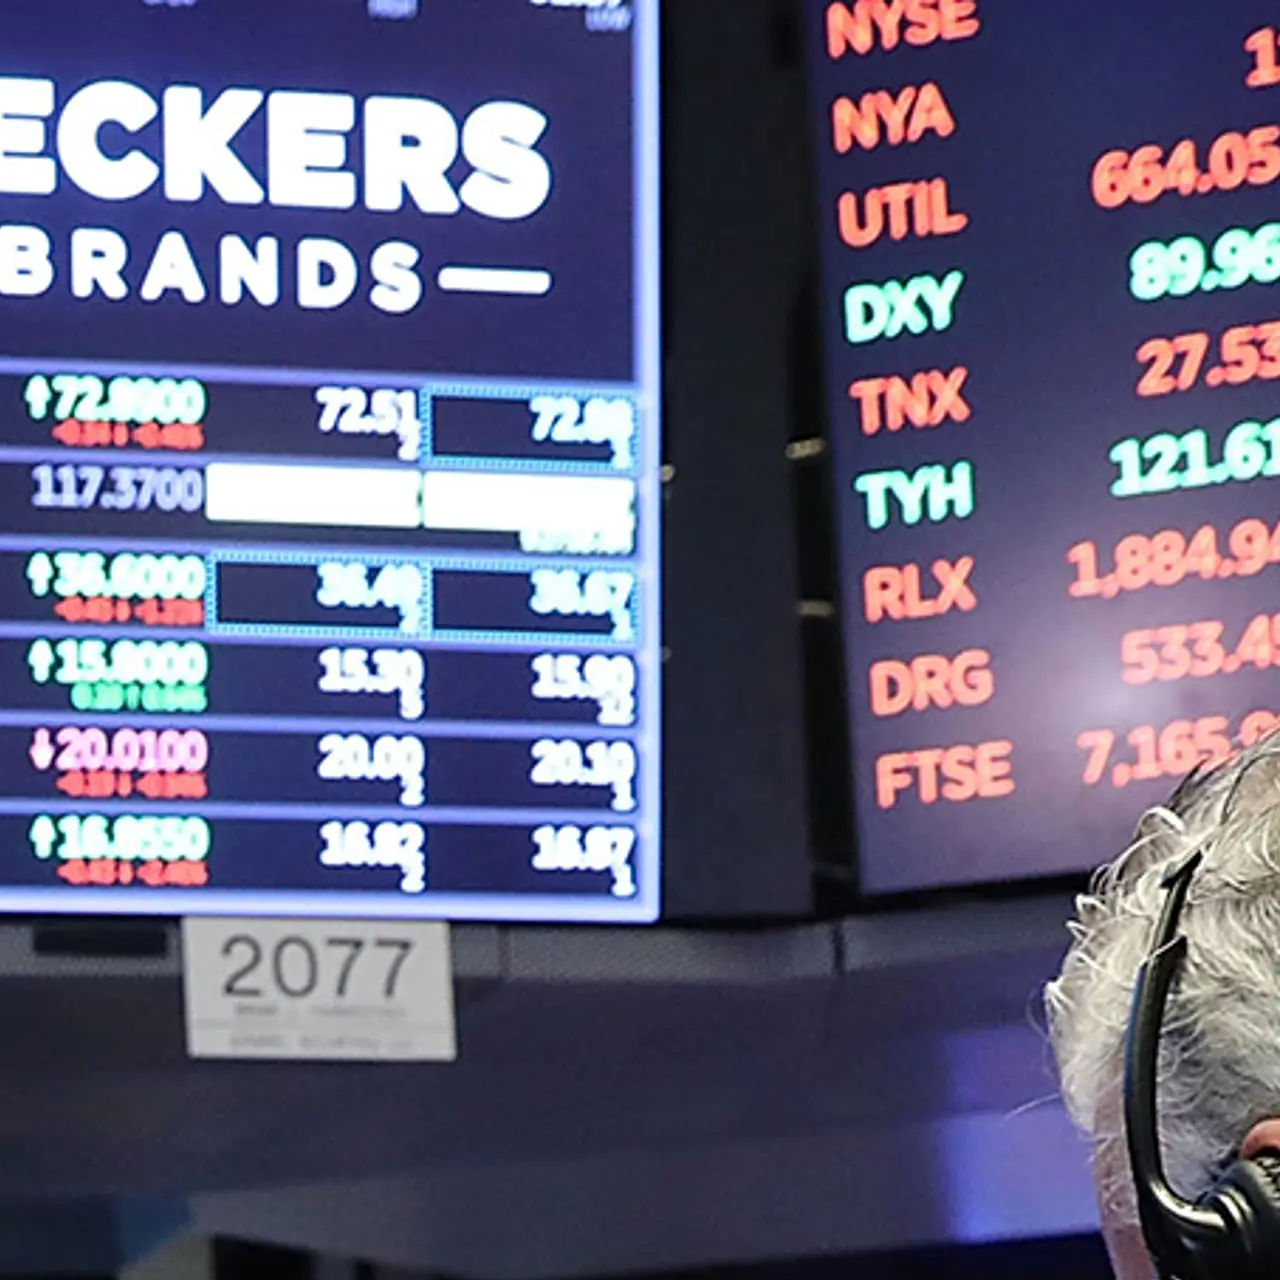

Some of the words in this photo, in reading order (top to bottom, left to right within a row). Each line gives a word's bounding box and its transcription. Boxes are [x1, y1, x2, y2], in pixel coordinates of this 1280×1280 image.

[826, 0, 981, 59] NYSE
[831, 82, 956, 154] NYA
[1091, 125, 1280, 209] 664.05
[838, 177, 969, 248] UTIL
[1129, 222, 1280, 301] 89.96
[844, 270, 964, 344] DXY
[1136, 322, 1280, 396] 27.53
[848, 366, 972, 435] TNX
[31, 464, 205, 511] 117.3700
[855, 460, 975, 530] TYH
[863, 556, 977, 623] RLX
[869, 648, 994, 718] DRG
[55, 728, 208, 771] 20.0100
[317, 735, 424, 779] 20.00
[875, 740, 1016, 810] FTSE
[221, 933, 413, 999] 2077
